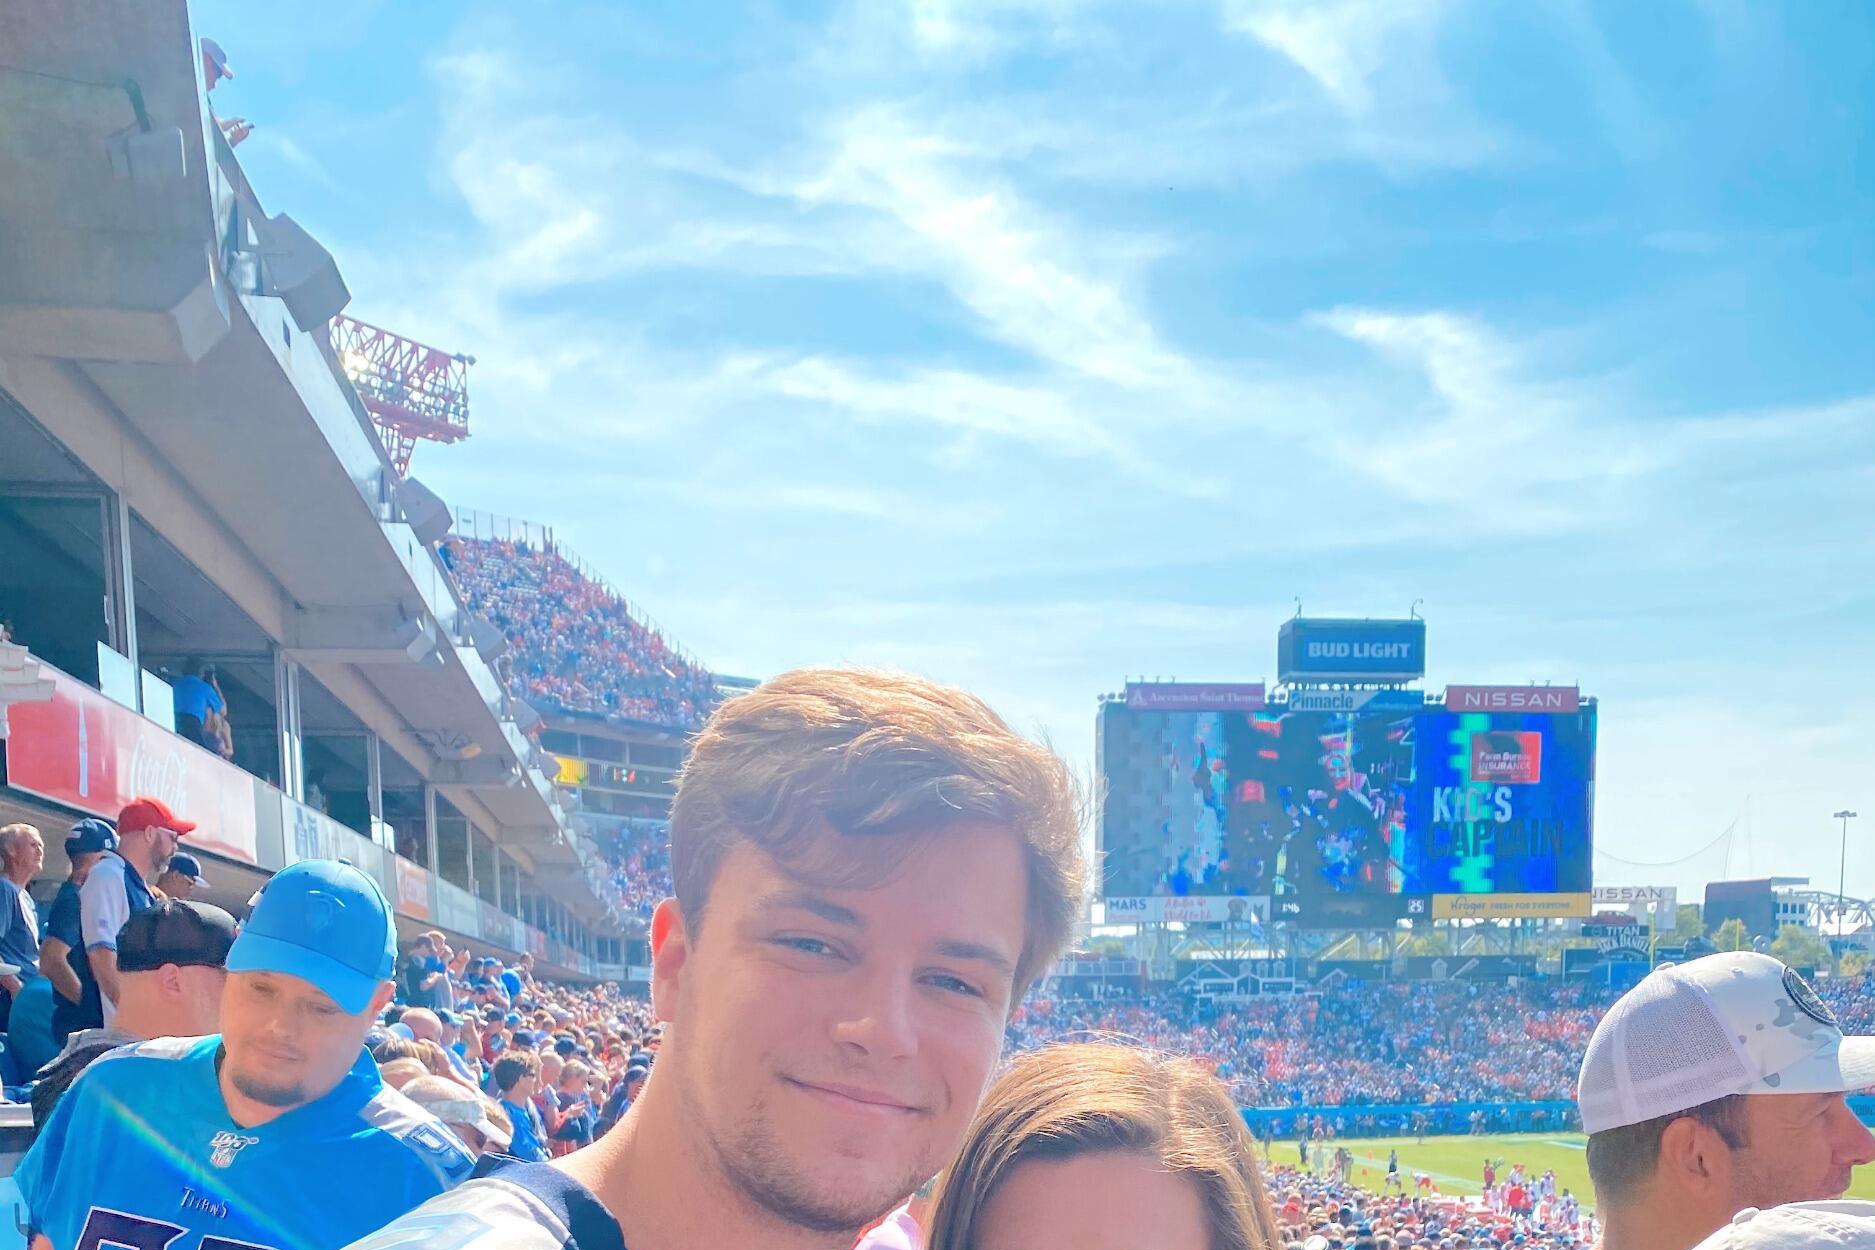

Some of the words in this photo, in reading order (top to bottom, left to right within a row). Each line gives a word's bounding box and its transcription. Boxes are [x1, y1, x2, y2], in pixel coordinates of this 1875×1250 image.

[1307, 642, 1350, 658] BUD
[1353, 643, 1411, 659] LIGHT
[1290, 690, 1354, 710] Pinnacle
[1464, 692, 1562, 708] NISSAN
[1109, 897, 1148, 912] MARS
[1450, 896, 1486, 916] Kroger
[1490, 902, 1514, 910] FRESH
[1515, 902, 1531, 910] FOR
[1606, 926, 1640, 937] TITAN
